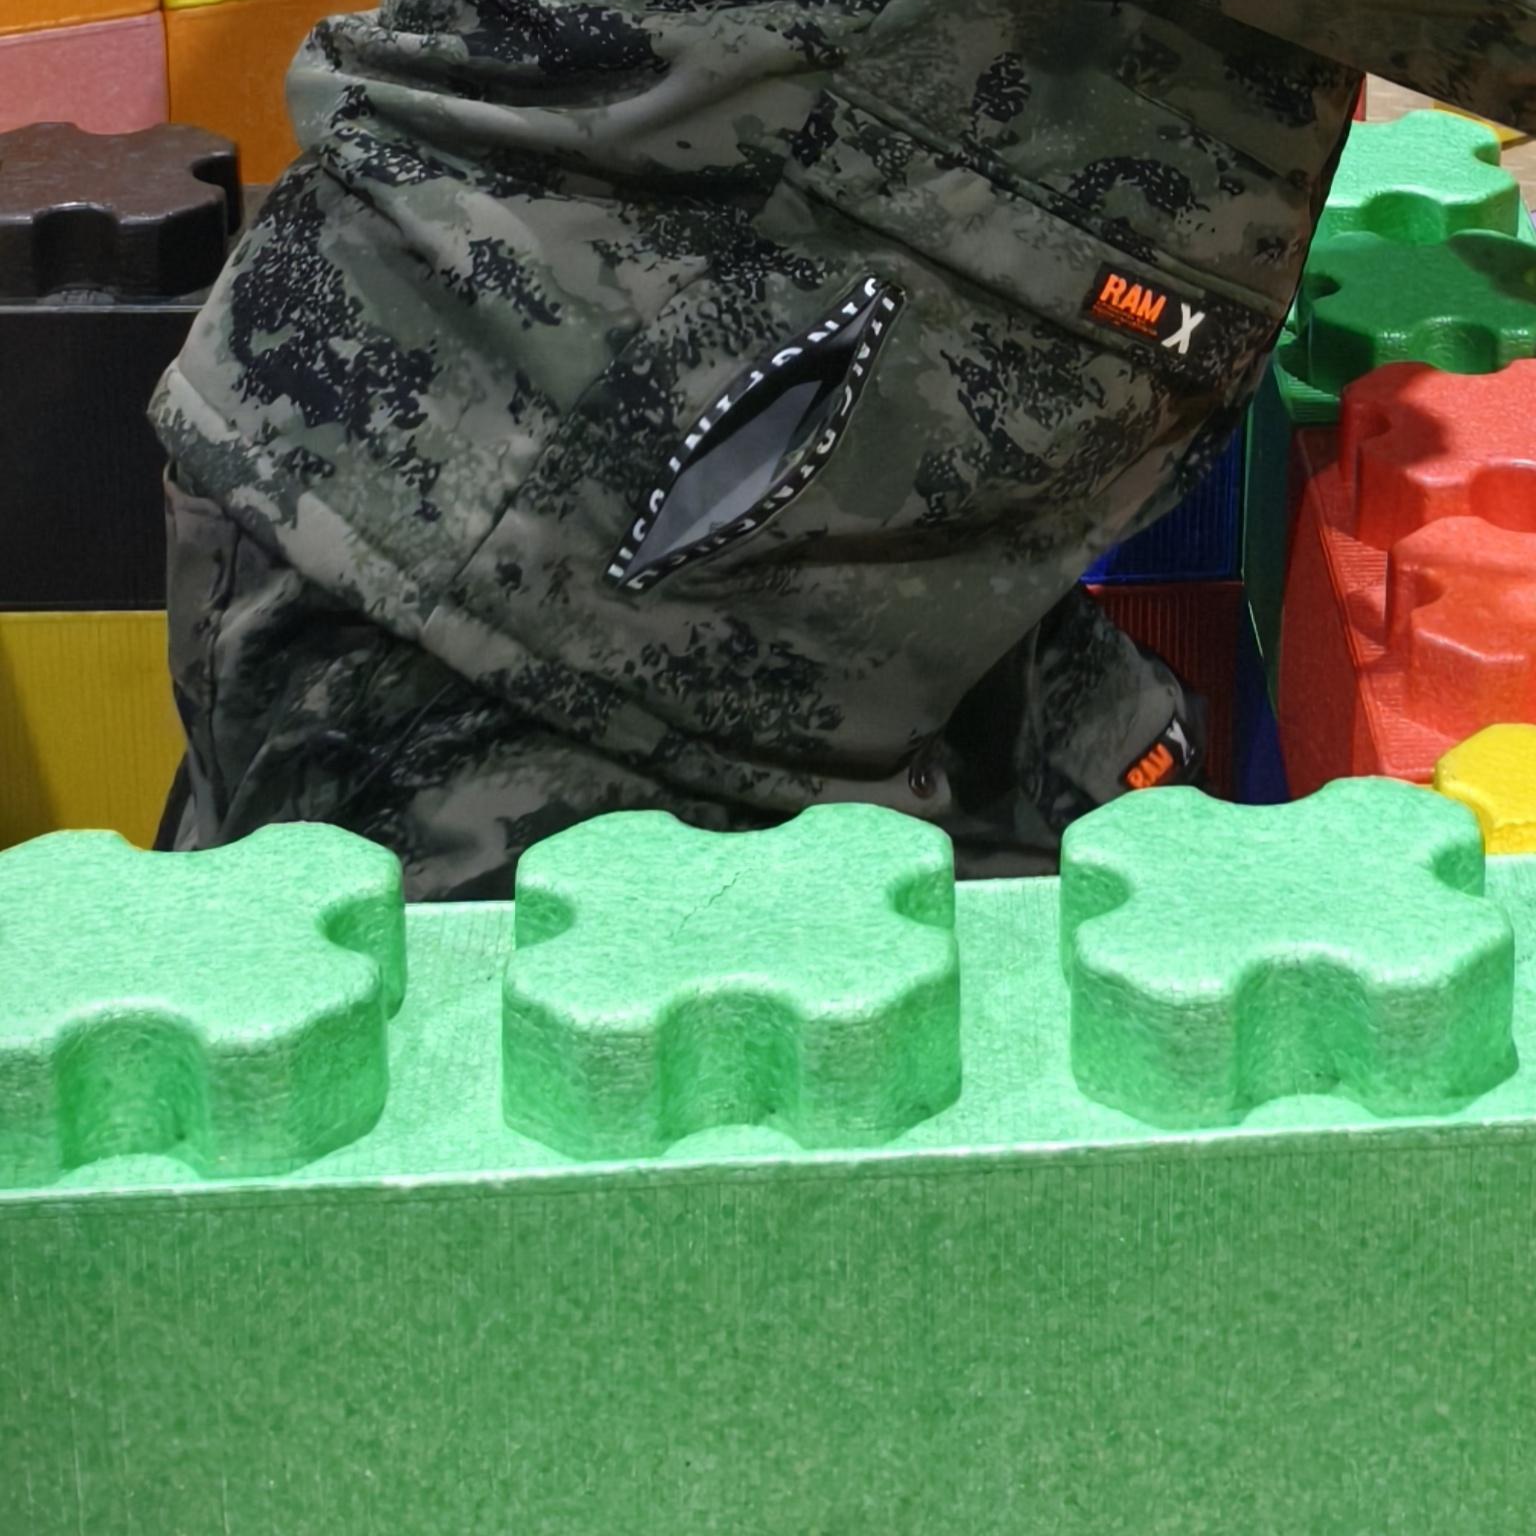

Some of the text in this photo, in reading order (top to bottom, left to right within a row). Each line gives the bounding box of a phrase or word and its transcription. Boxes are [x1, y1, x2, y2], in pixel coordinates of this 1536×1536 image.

[1100, 274, 1167, 323] RAM
[1161, 302, 1205, 354] X
[1127, 742, 1174, 789] RAM
